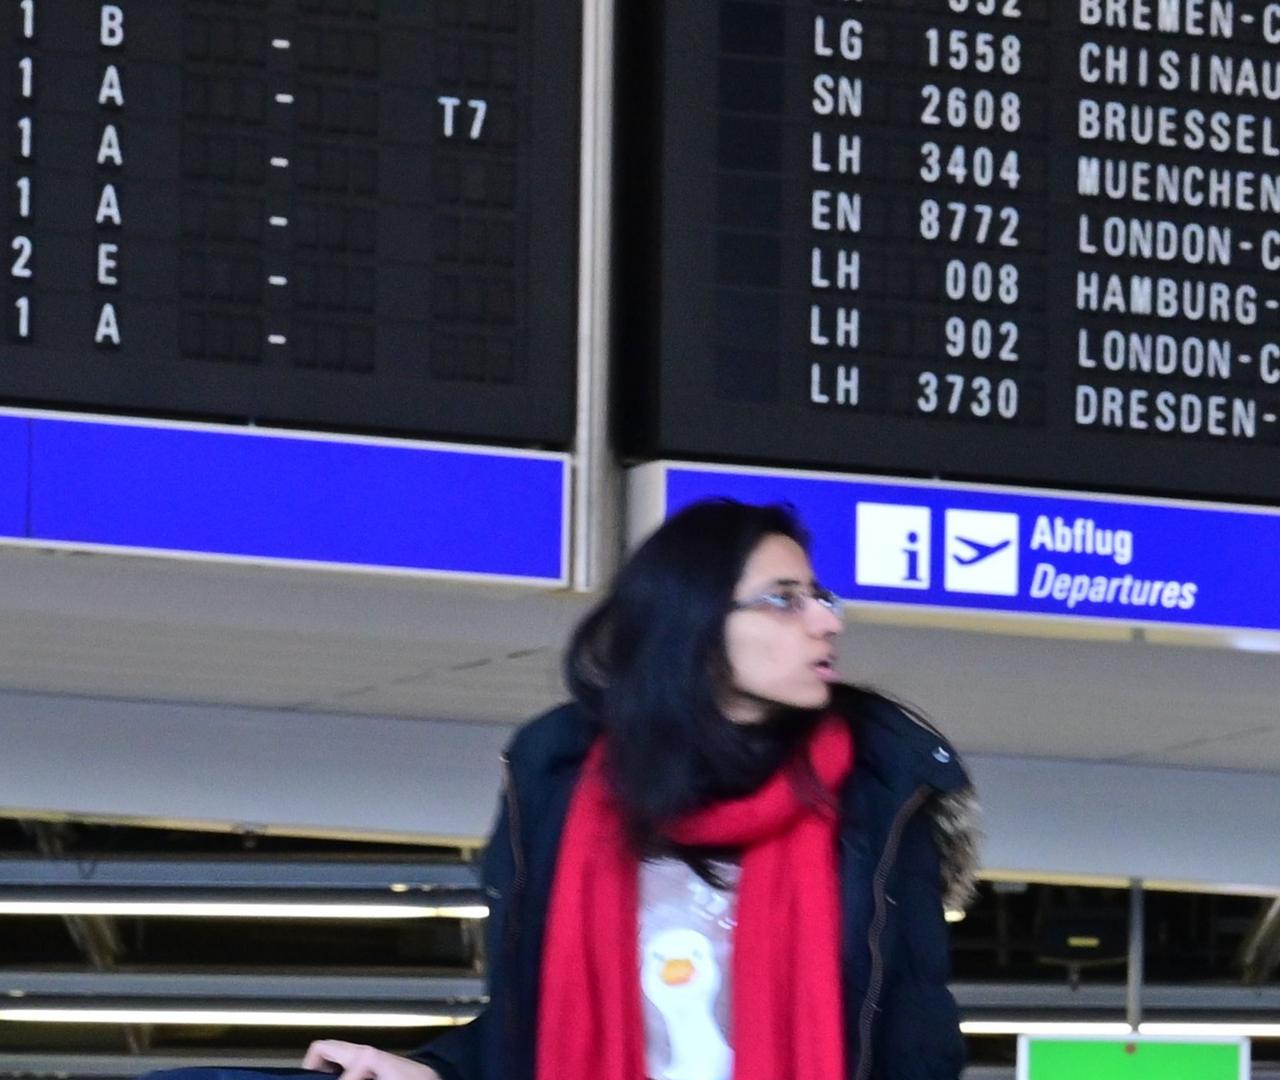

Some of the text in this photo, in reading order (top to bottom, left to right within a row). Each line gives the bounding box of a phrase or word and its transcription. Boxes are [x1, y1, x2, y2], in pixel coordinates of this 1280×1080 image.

[99, 4, 125, 47] B
[813, 15, 864, 62] LG
[924, 27, 1022, 76] 1558
[18, 56, 34, 99] 1
[97, 64, 125, 107] A
[436, 95, 488, 140] T7
[811, 73, 863, 118] SN
[919, 83, 1022, 133] 2608
[17, 116, 33, 159] 1
[96, 123, 124, 167] A
[811, 131, 862, 175] LH
[919, 141, 1022, 190] 3404
[15, 176, 31, 218] 1
[94, 182, 123, 226] A
[810, 189, 862, 234] EN
[918, 198, 1020, 248] 8772
[10, 234, 33, 279] 2
[96, 242, 119, 286] E
[810, 246, 861, 291] LH
[944, 258, 1020, 306] 008
[14, 295, 30, 338] 1
[94, 301, 122, 345] A
[809, 304, 860, 349] LH
[944, 315, 1019, 363] 902
[809, 362, 860, 406] LH
[916, 370, 1019, 420] 3730
[1028, 513, 1134, 566] Abflug
[1028, 563, 1199, 611] Departures
